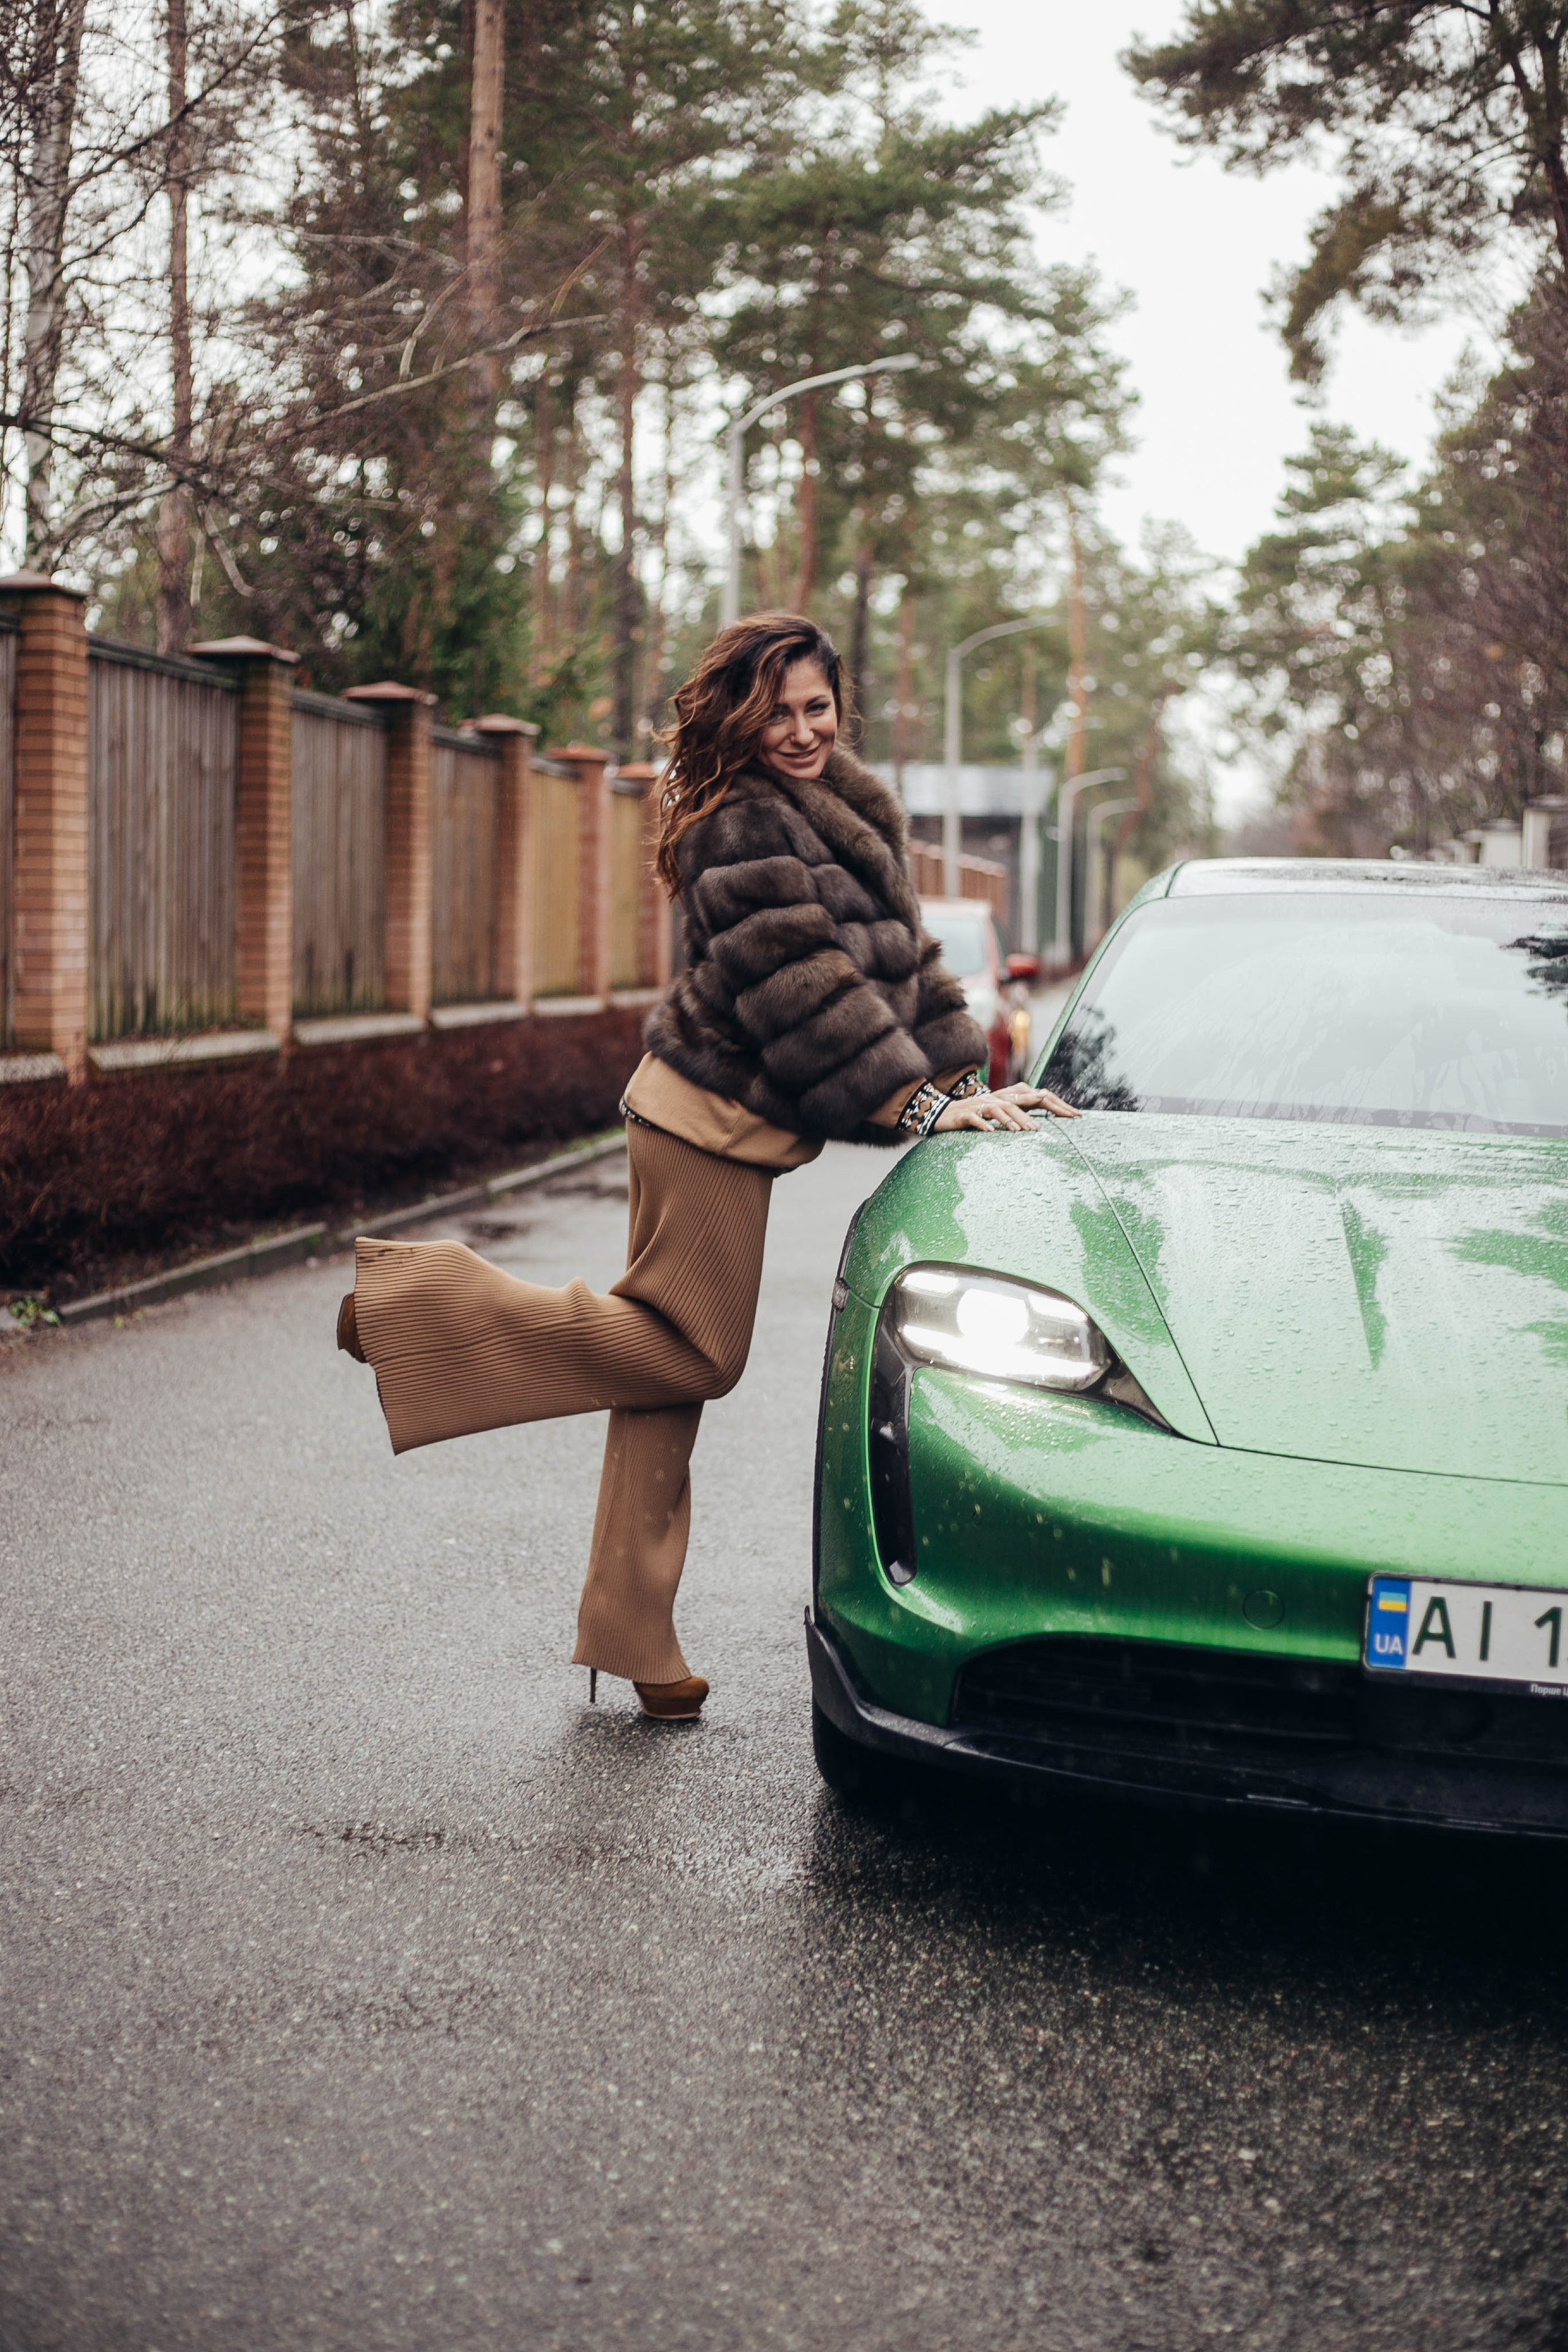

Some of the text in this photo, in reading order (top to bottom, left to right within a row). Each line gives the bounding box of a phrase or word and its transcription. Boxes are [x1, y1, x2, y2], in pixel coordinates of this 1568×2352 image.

[1411, 1596, 1493, 1661] AI
[1374, 1633, 1403, 1655] UA
[1531, 1684, 1561, 1696] Порше
